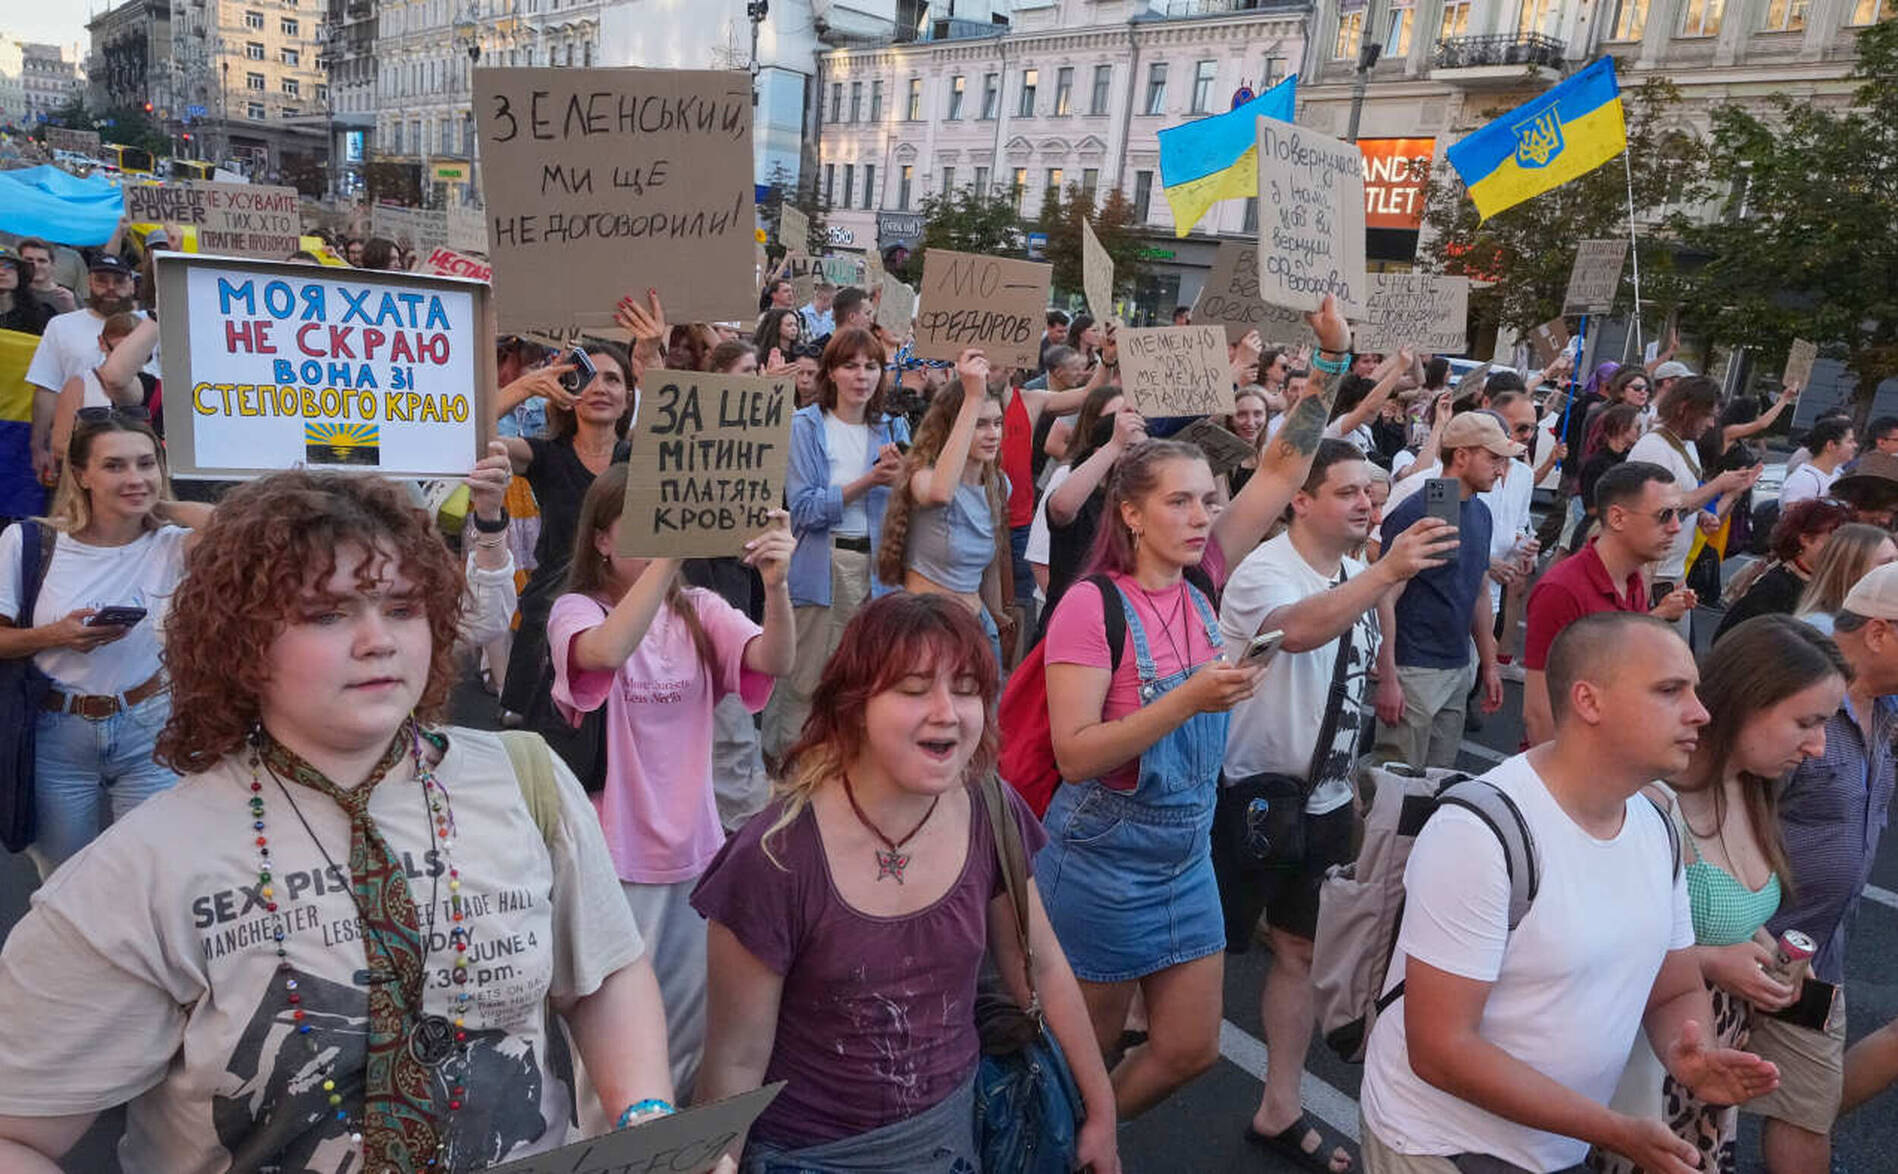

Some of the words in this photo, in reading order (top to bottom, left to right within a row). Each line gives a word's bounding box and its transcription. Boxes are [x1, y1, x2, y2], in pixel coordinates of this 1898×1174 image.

[491, 91, 750, 142] ЗЕЛЕНСЬКИЙ,
[541, 164, 592, 195] МИ
[613, 160, 669, 195] ЩЕ
[1361, 154, 1427, 182] ANDS
[129, 186, 183, 205] SOURCE
[187, 187, 206, 206] OF
[130, 203, 206, 224] POWER
[1365, 187, 1420, 214] TLET
[258, 215, 291, 232] ХТО
[217, 276, 326, 322] МОЯ
[338, 286, 451, 331] ХАТА
[225, 320, 278, 354] НЕ
[295, 322, 450, 366] СКРАЮ
[921, 309, 1032, 344] ФЕДОРОВ
[273, 358, 378, 390] ВОНА
[192, 382, 377, 420] СТЕПОВОГО
[384, 391, 470, 424] КРАЮ
[651, 383, 704, 436] ЗА
[718, 384, 784, 431] ЦЕЙ
[661, 476, 773, 503] ПЛАТЯТЬ
[192, 882, 268, 929] SEX
[284, 848, 446, 902] PISLS
[199, 905, 319, 961] MANCHESTER
[322, 917, 363, 948] LESS
[499, 888, 534, 915] HALL
[468, 936, 526, 964] JUNE
[528, 931, 538, 947] 4
